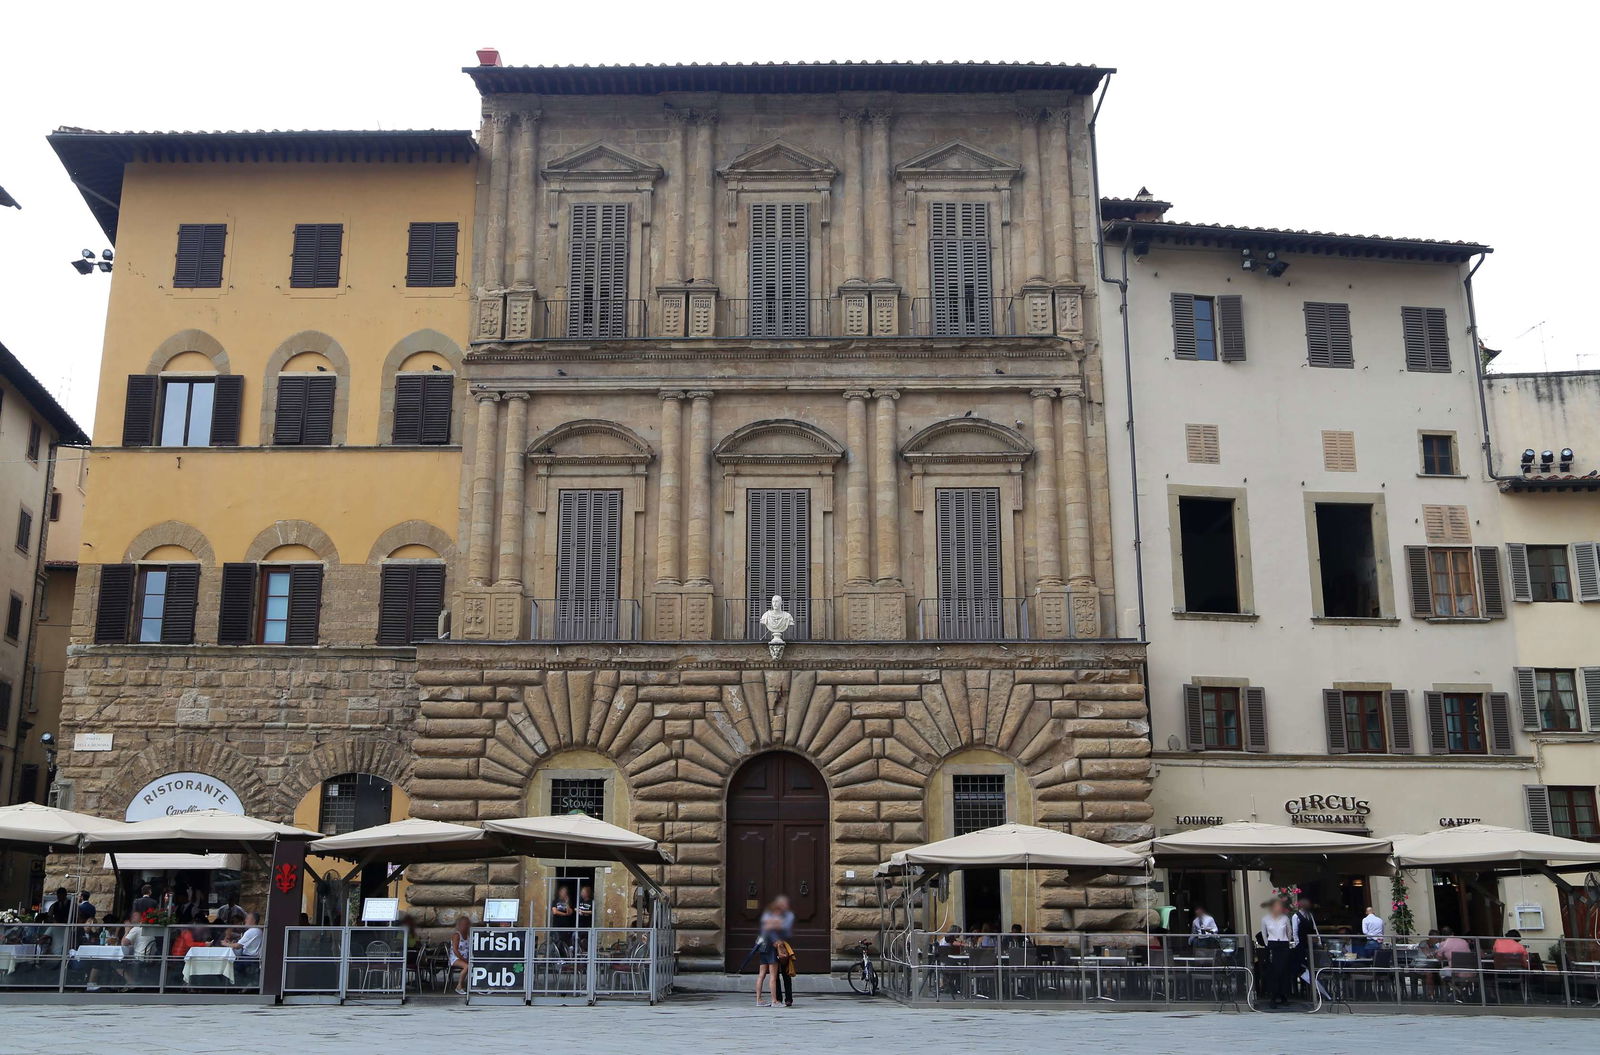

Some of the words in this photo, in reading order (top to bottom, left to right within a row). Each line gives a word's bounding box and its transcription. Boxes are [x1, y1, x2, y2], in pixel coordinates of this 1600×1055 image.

[143, 780, 229, 805] RISTORANTE
[569, 786, 589, 798] Old
[562, 797, 594, 809] Stove
[1284, 794, 1371, 815] CIRCUS
[165, 804, 202, 816] Cavalli
[1176, 815, 1223, 826] LOUNGE
[1291, 814, 1366, 825] RISTORANTE
[473, 932, 521, 951] Irish
[471, 966, 516, 987] Pub
